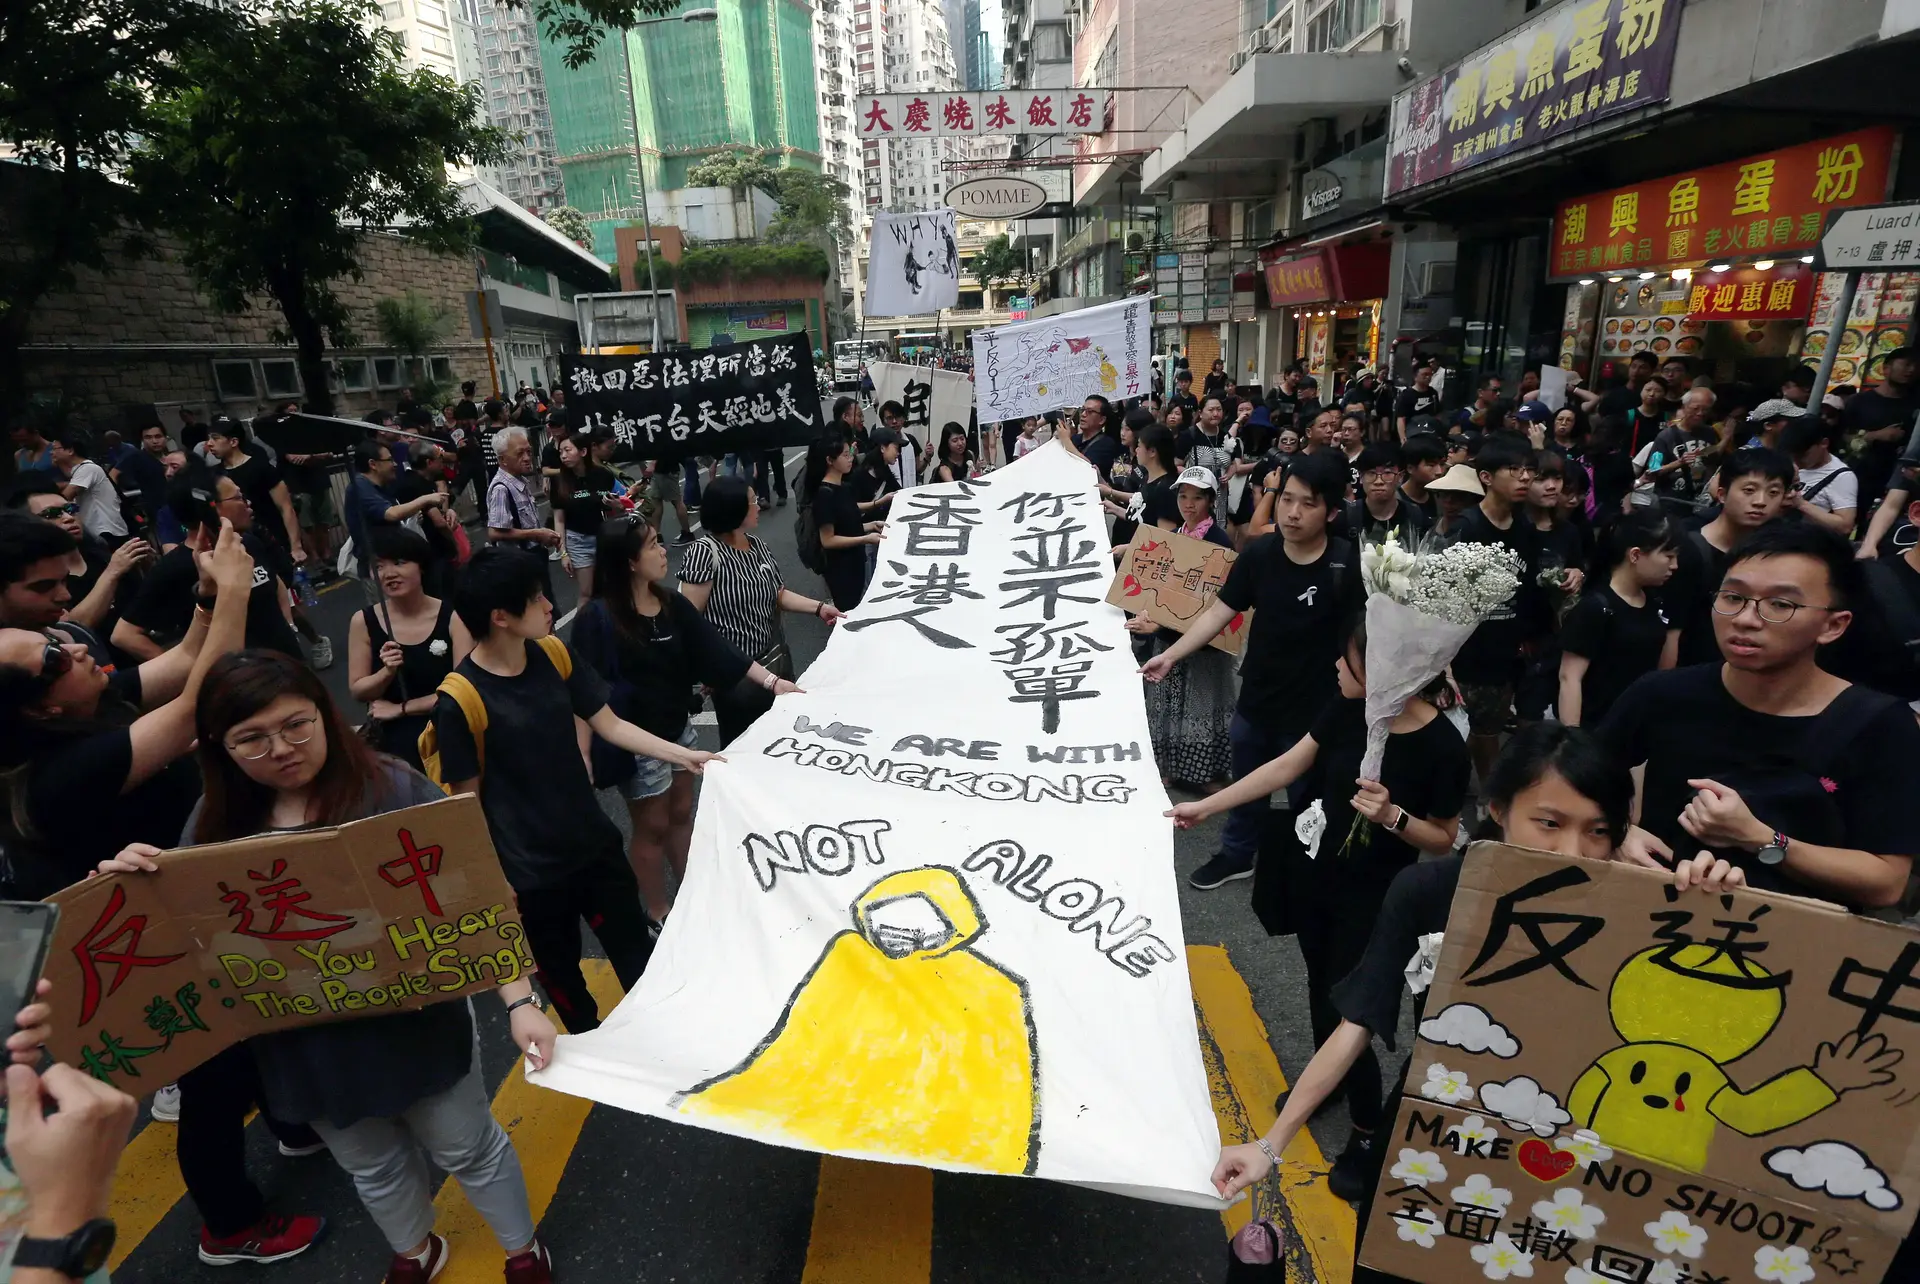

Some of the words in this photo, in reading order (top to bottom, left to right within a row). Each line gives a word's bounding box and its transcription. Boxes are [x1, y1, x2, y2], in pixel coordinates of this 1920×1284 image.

[1449, 0, 1664, 134] 潮興魚蛋粉
[864, 92, 1094, 133] 大慶燒味飯店
[1451, 117, 1524, 164] 正宗潮州食品
[1538, 70, 1641, 129] 老火靚骨湯底
[961, 188, 1031, 205] POMME
[1562, 143, 1864, 245] 潮興魚蛋粉
[1866, 212, 1913, 230] Luard
[1560, 238, 1653, 271] 正宗潮州食品
[1836, 246, 1861, 258] 7-13
[1867, 239, 1920, 261] 盧押
[1688, 279, 1797, 314] 歡迎惠顧
[570, 344, 797, 396] 撤回惡法理所當然
[990, 491, 1114, 735] 你並不孤單
[763, 737, 1137, 804] HONGKONG
[794, 714, 873, 746] WE
[891, 734, 1002, 761] ARE
[1026, 741, 1142, 764] WITH
[72, 828, 444, 1028] 反送中
[742, 819, 891, 892] NOT
[962, 839, 1177, 978] ALONE
[219, 953, 288, 988] Do
[294, 940, 376, 978] You
[386, 903, 506, 960] Hear
[242, 992, 320, 1018] The
[320, 972, 435, 1013] People
[427, 922, 533, 992] Sing?
[1460, 865, 1920, 1035] 反送中
[1405, 1110, 1513, 1161] MAKE
[1583, 1160, 1653, 1198] NO
